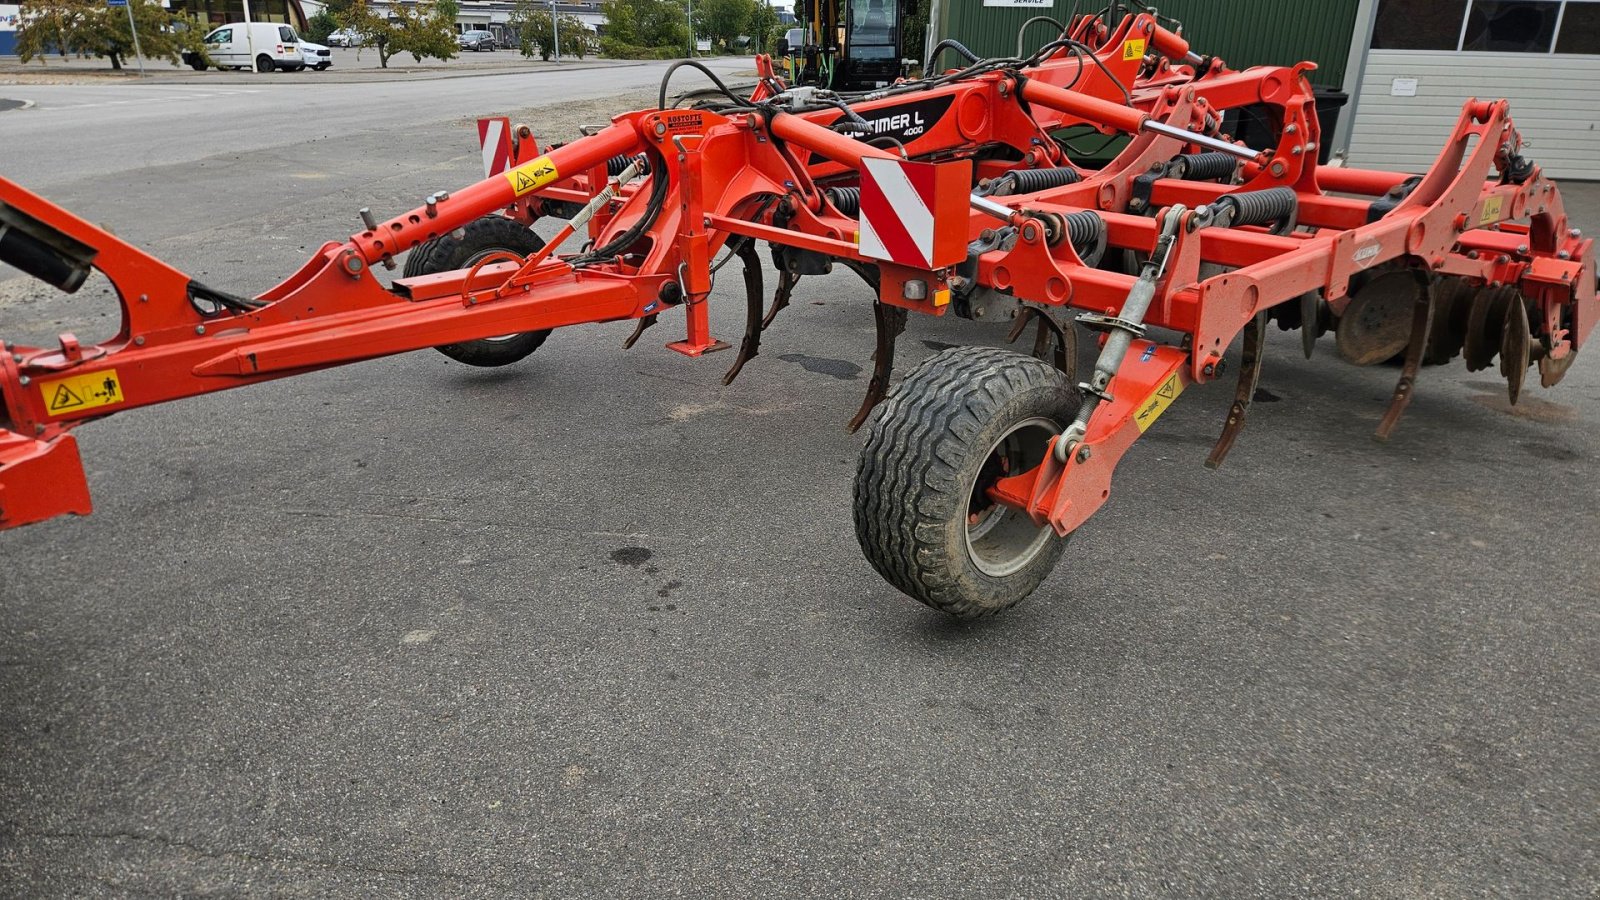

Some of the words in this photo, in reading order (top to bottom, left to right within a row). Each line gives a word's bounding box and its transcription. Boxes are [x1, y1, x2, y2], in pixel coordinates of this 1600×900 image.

[843, 113, 911, 139] TIMER
[914, 111, 924, 125] L
[903, 126, 924, 137] 4000
